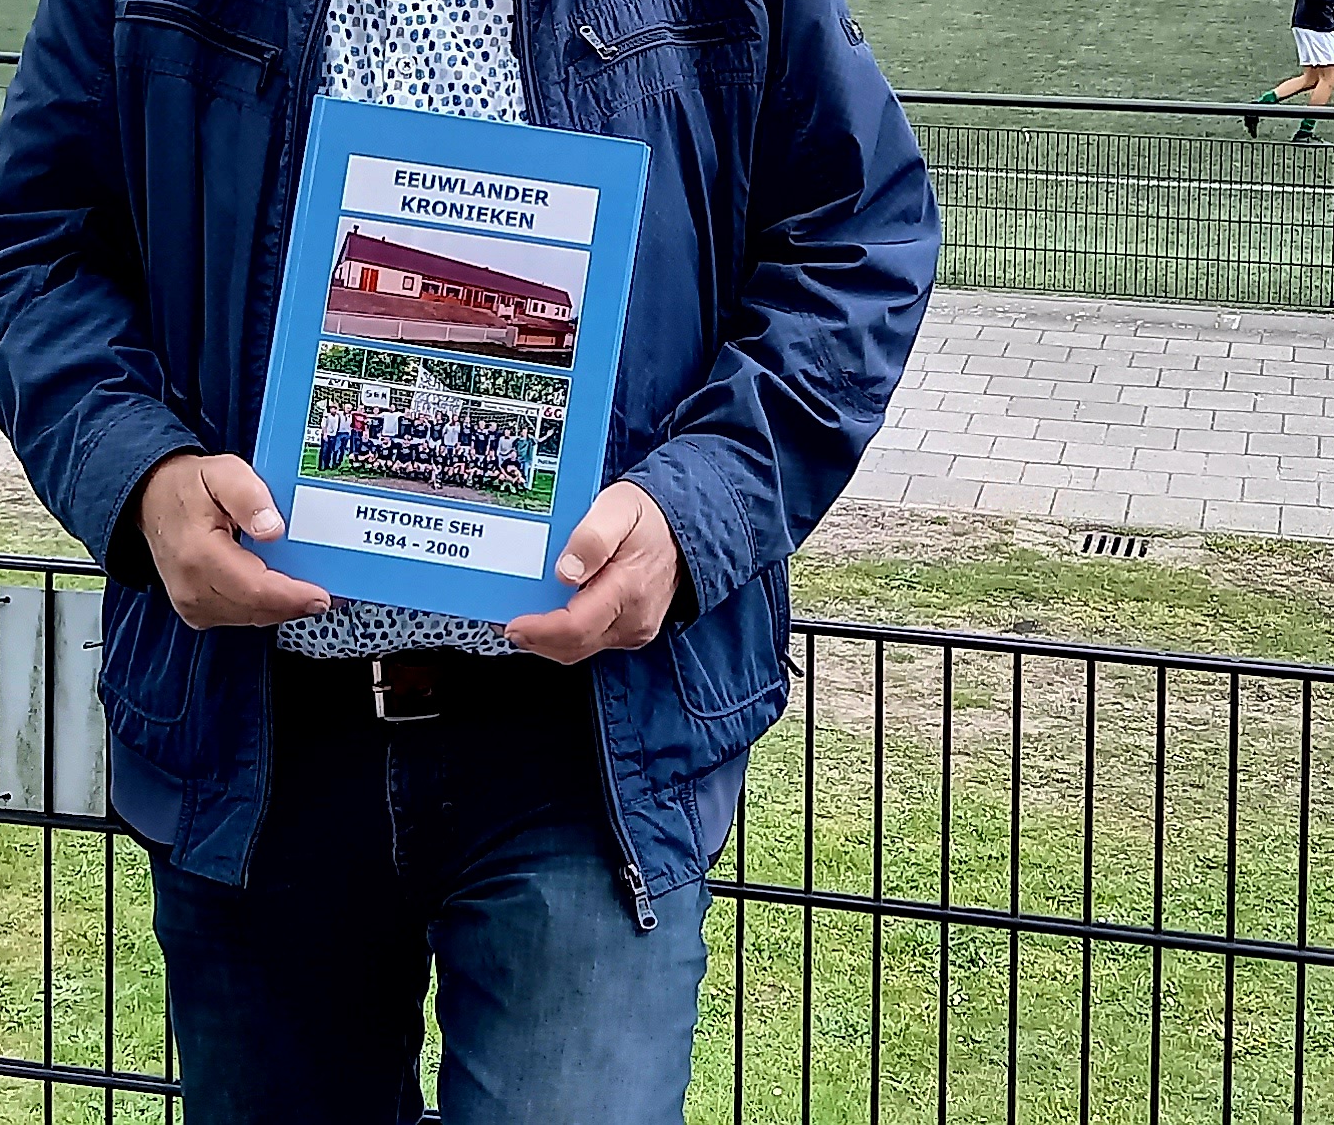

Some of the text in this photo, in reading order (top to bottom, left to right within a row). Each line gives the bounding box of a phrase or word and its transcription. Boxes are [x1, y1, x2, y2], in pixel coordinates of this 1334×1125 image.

[394, 169, 549, 207] EEUWLANDER
[400, 195, 535, 230] KRONIEKEN
[356, 505, 484, 538] HISTORIE SEH
[363, 529, 407, 549] 1984
[425, 539, 470, 559] 2000
